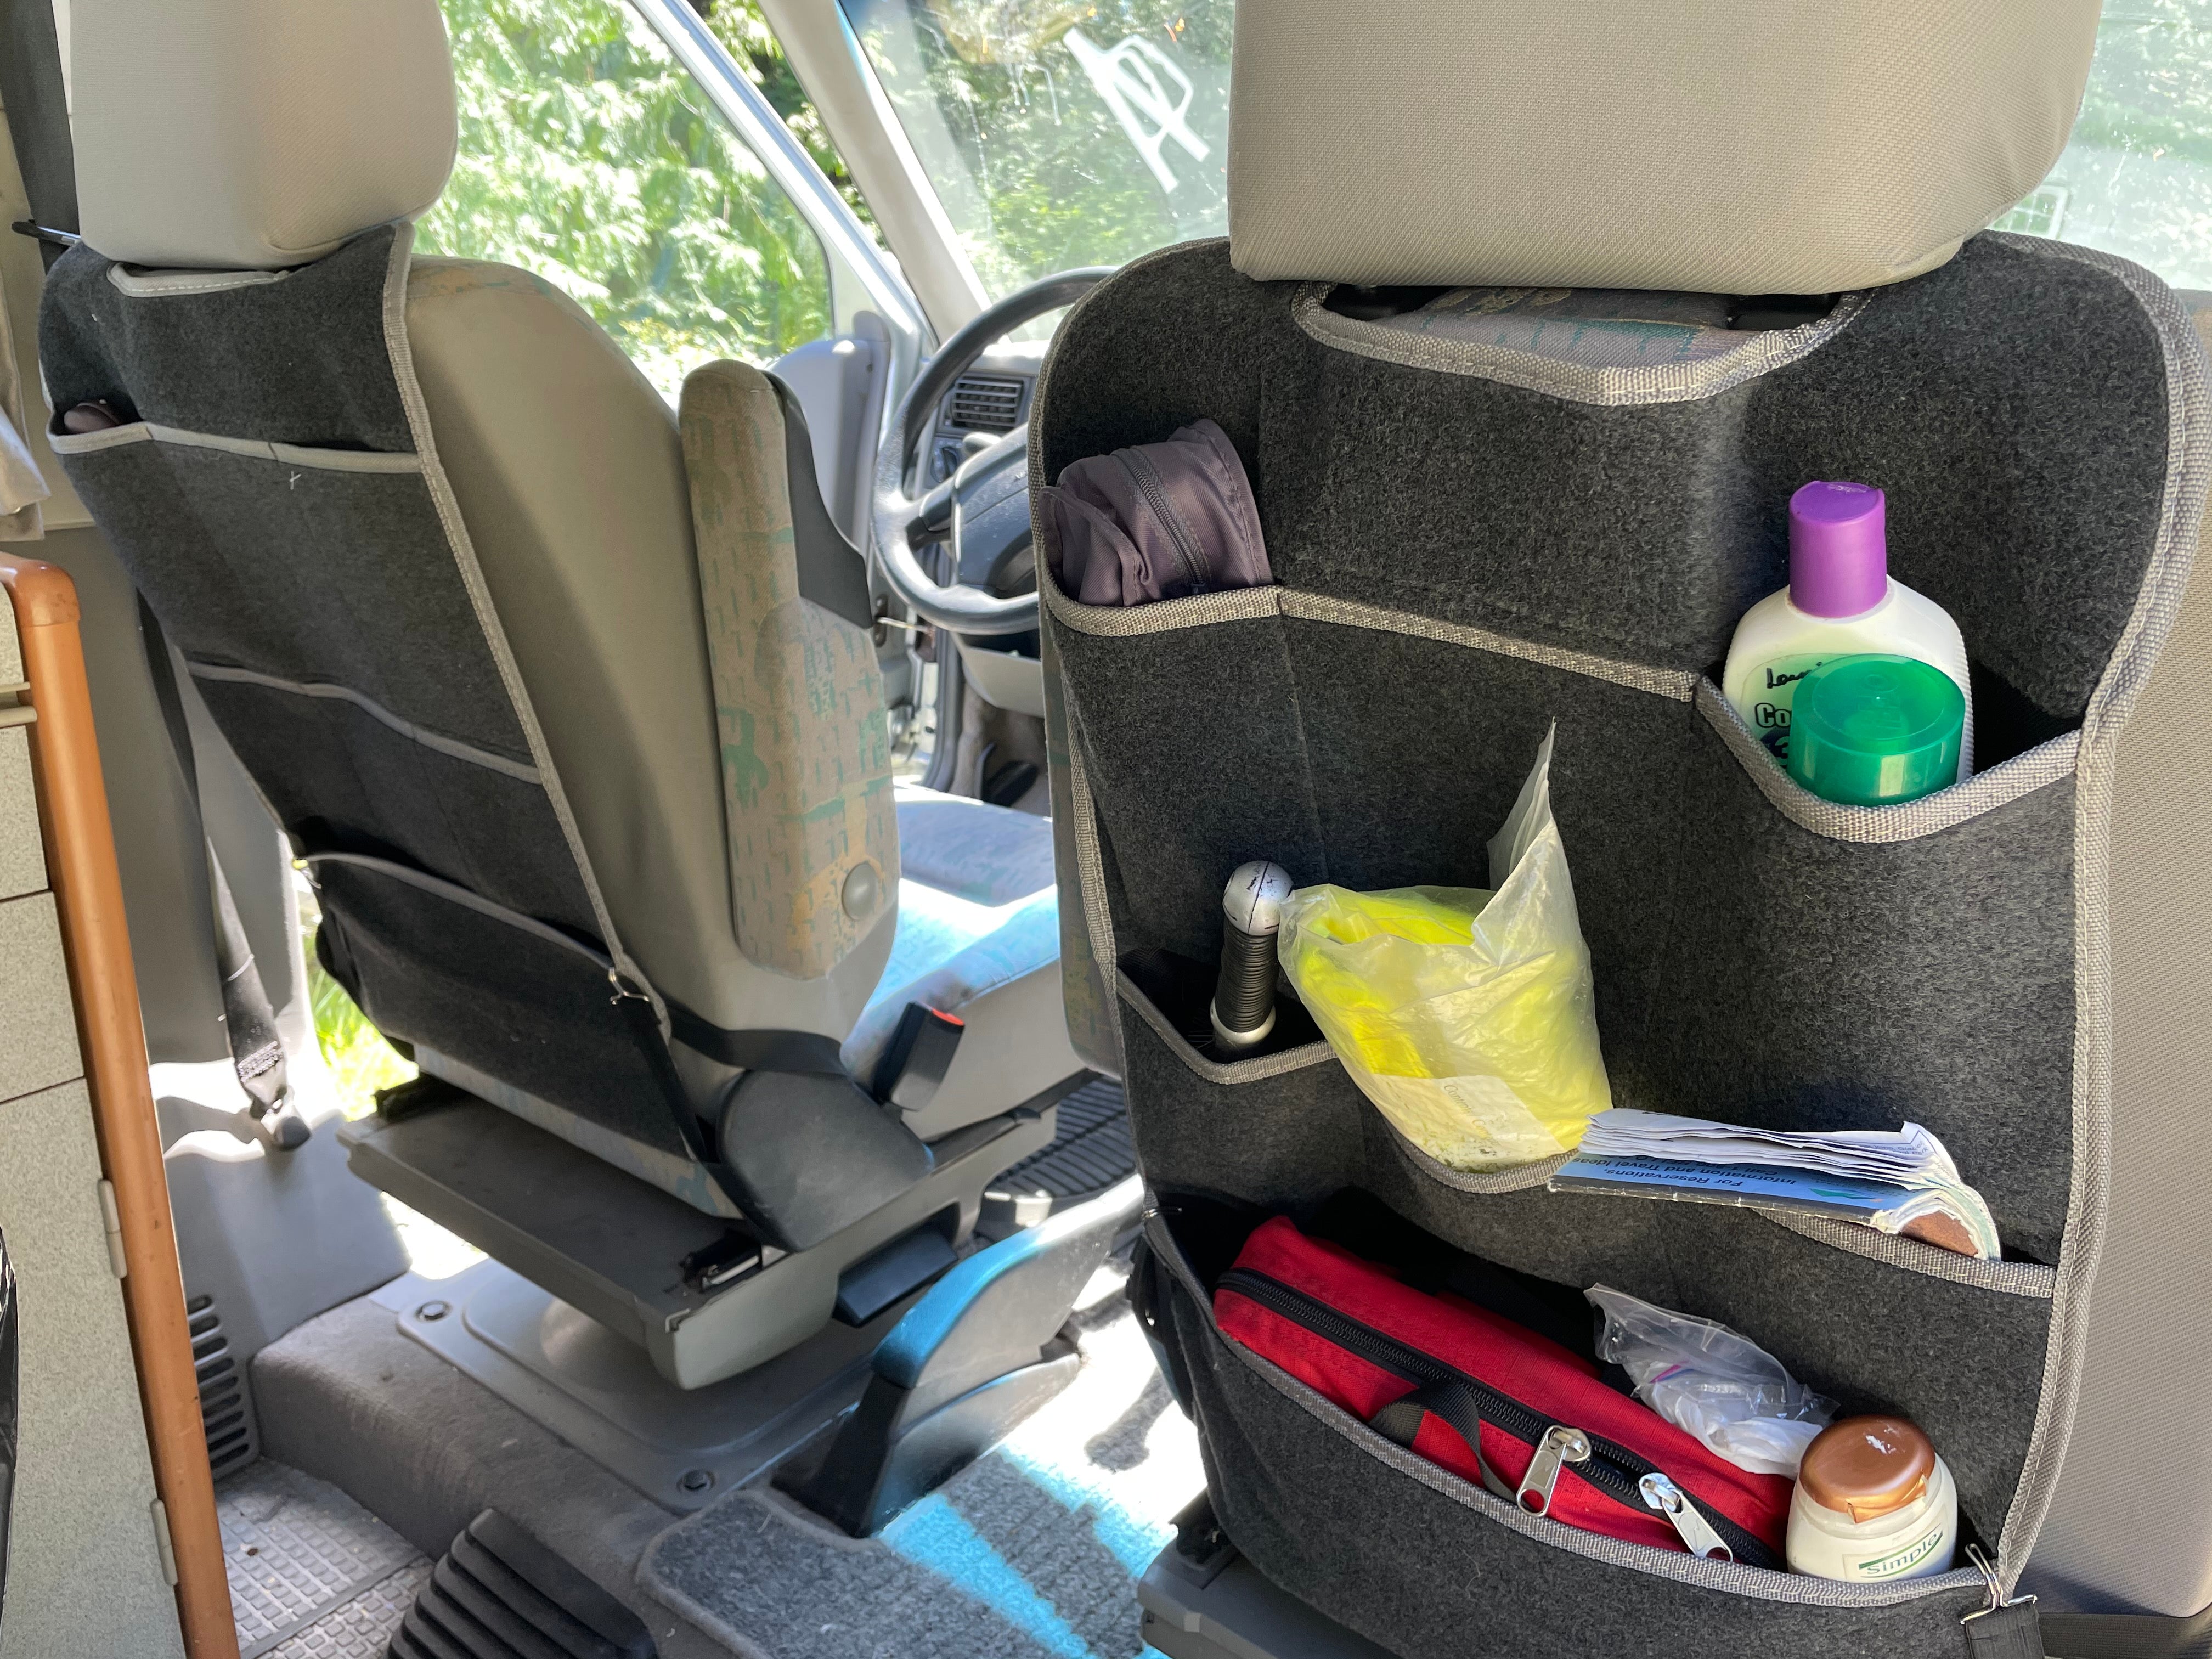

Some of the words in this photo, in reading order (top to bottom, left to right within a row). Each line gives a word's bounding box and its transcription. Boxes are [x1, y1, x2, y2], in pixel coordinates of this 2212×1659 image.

[1571, 1157, 1612, 1167] Ideas
[1615, 1160, 1660, 1171] Travel
[1604, 1169, 1710, 1183] Reservations,
[1700, 1168, 1797, 1185] Information
[1745, 1167, 1779, 1176] Call
[1714, 1178, 1743, 1187] For
[1867, 1533, 1937, 1575] Simple
